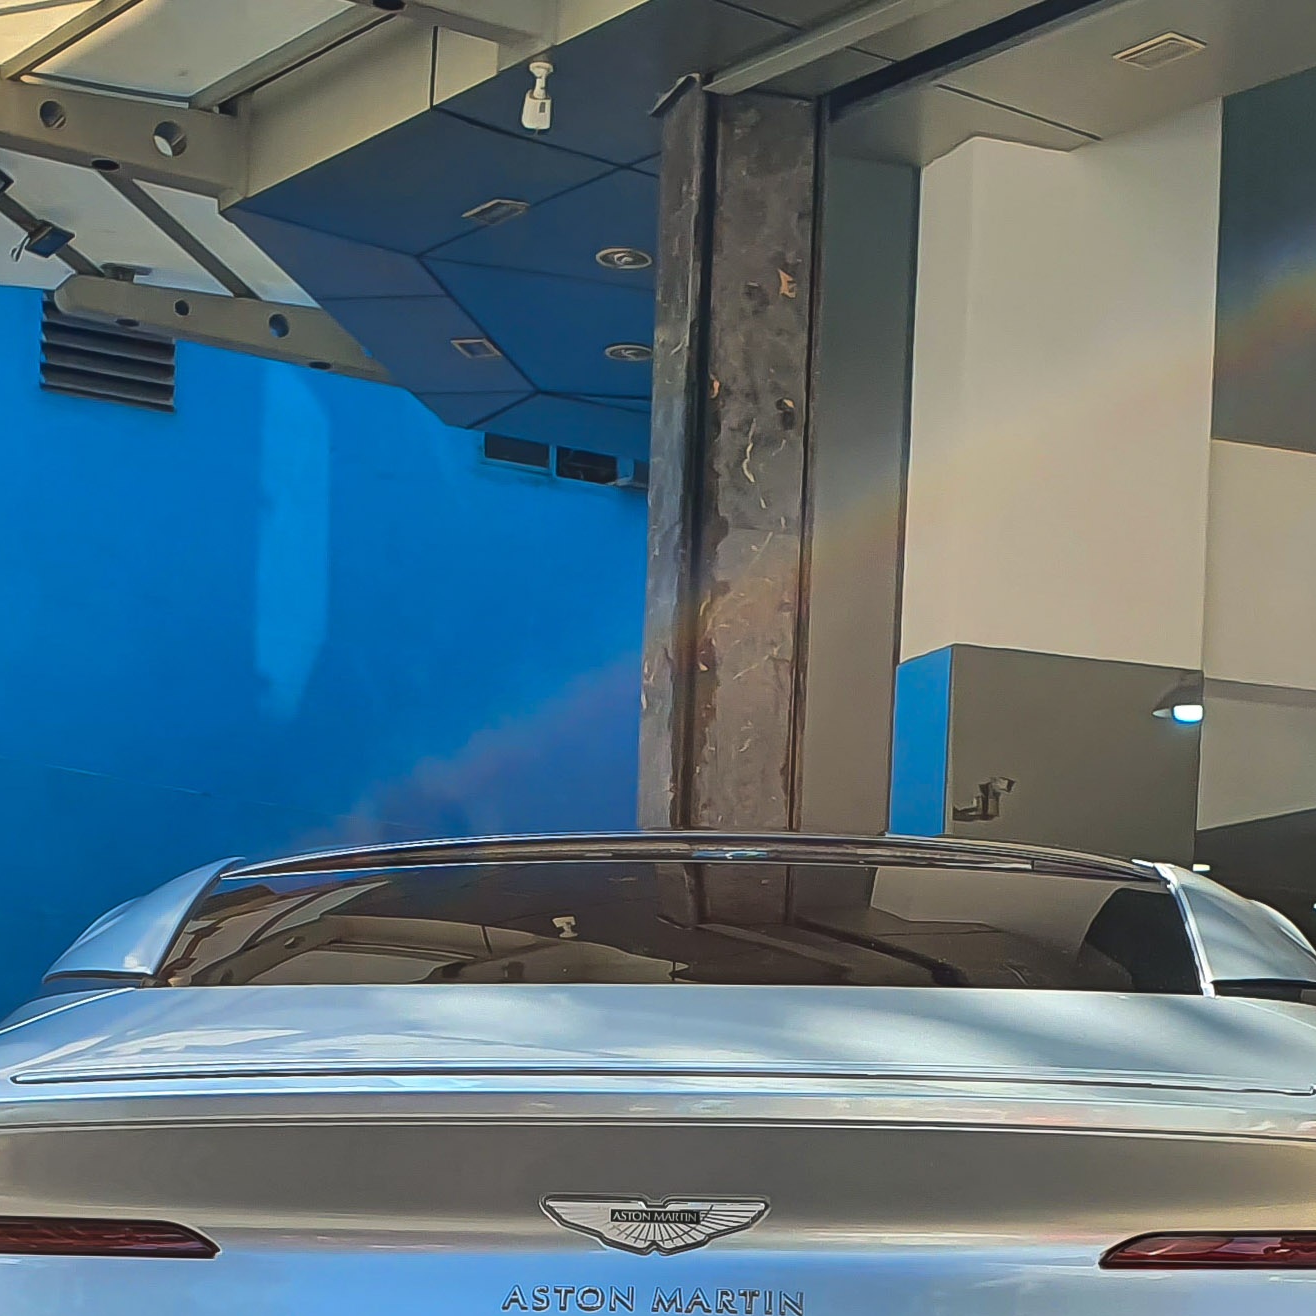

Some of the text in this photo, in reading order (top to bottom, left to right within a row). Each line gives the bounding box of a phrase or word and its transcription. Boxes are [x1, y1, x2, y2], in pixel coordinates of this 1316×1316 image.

[613, 1211, 697, 1222] ASTON MARTIN
[501, 1285, 805, 1316] ASTON MARTIN
